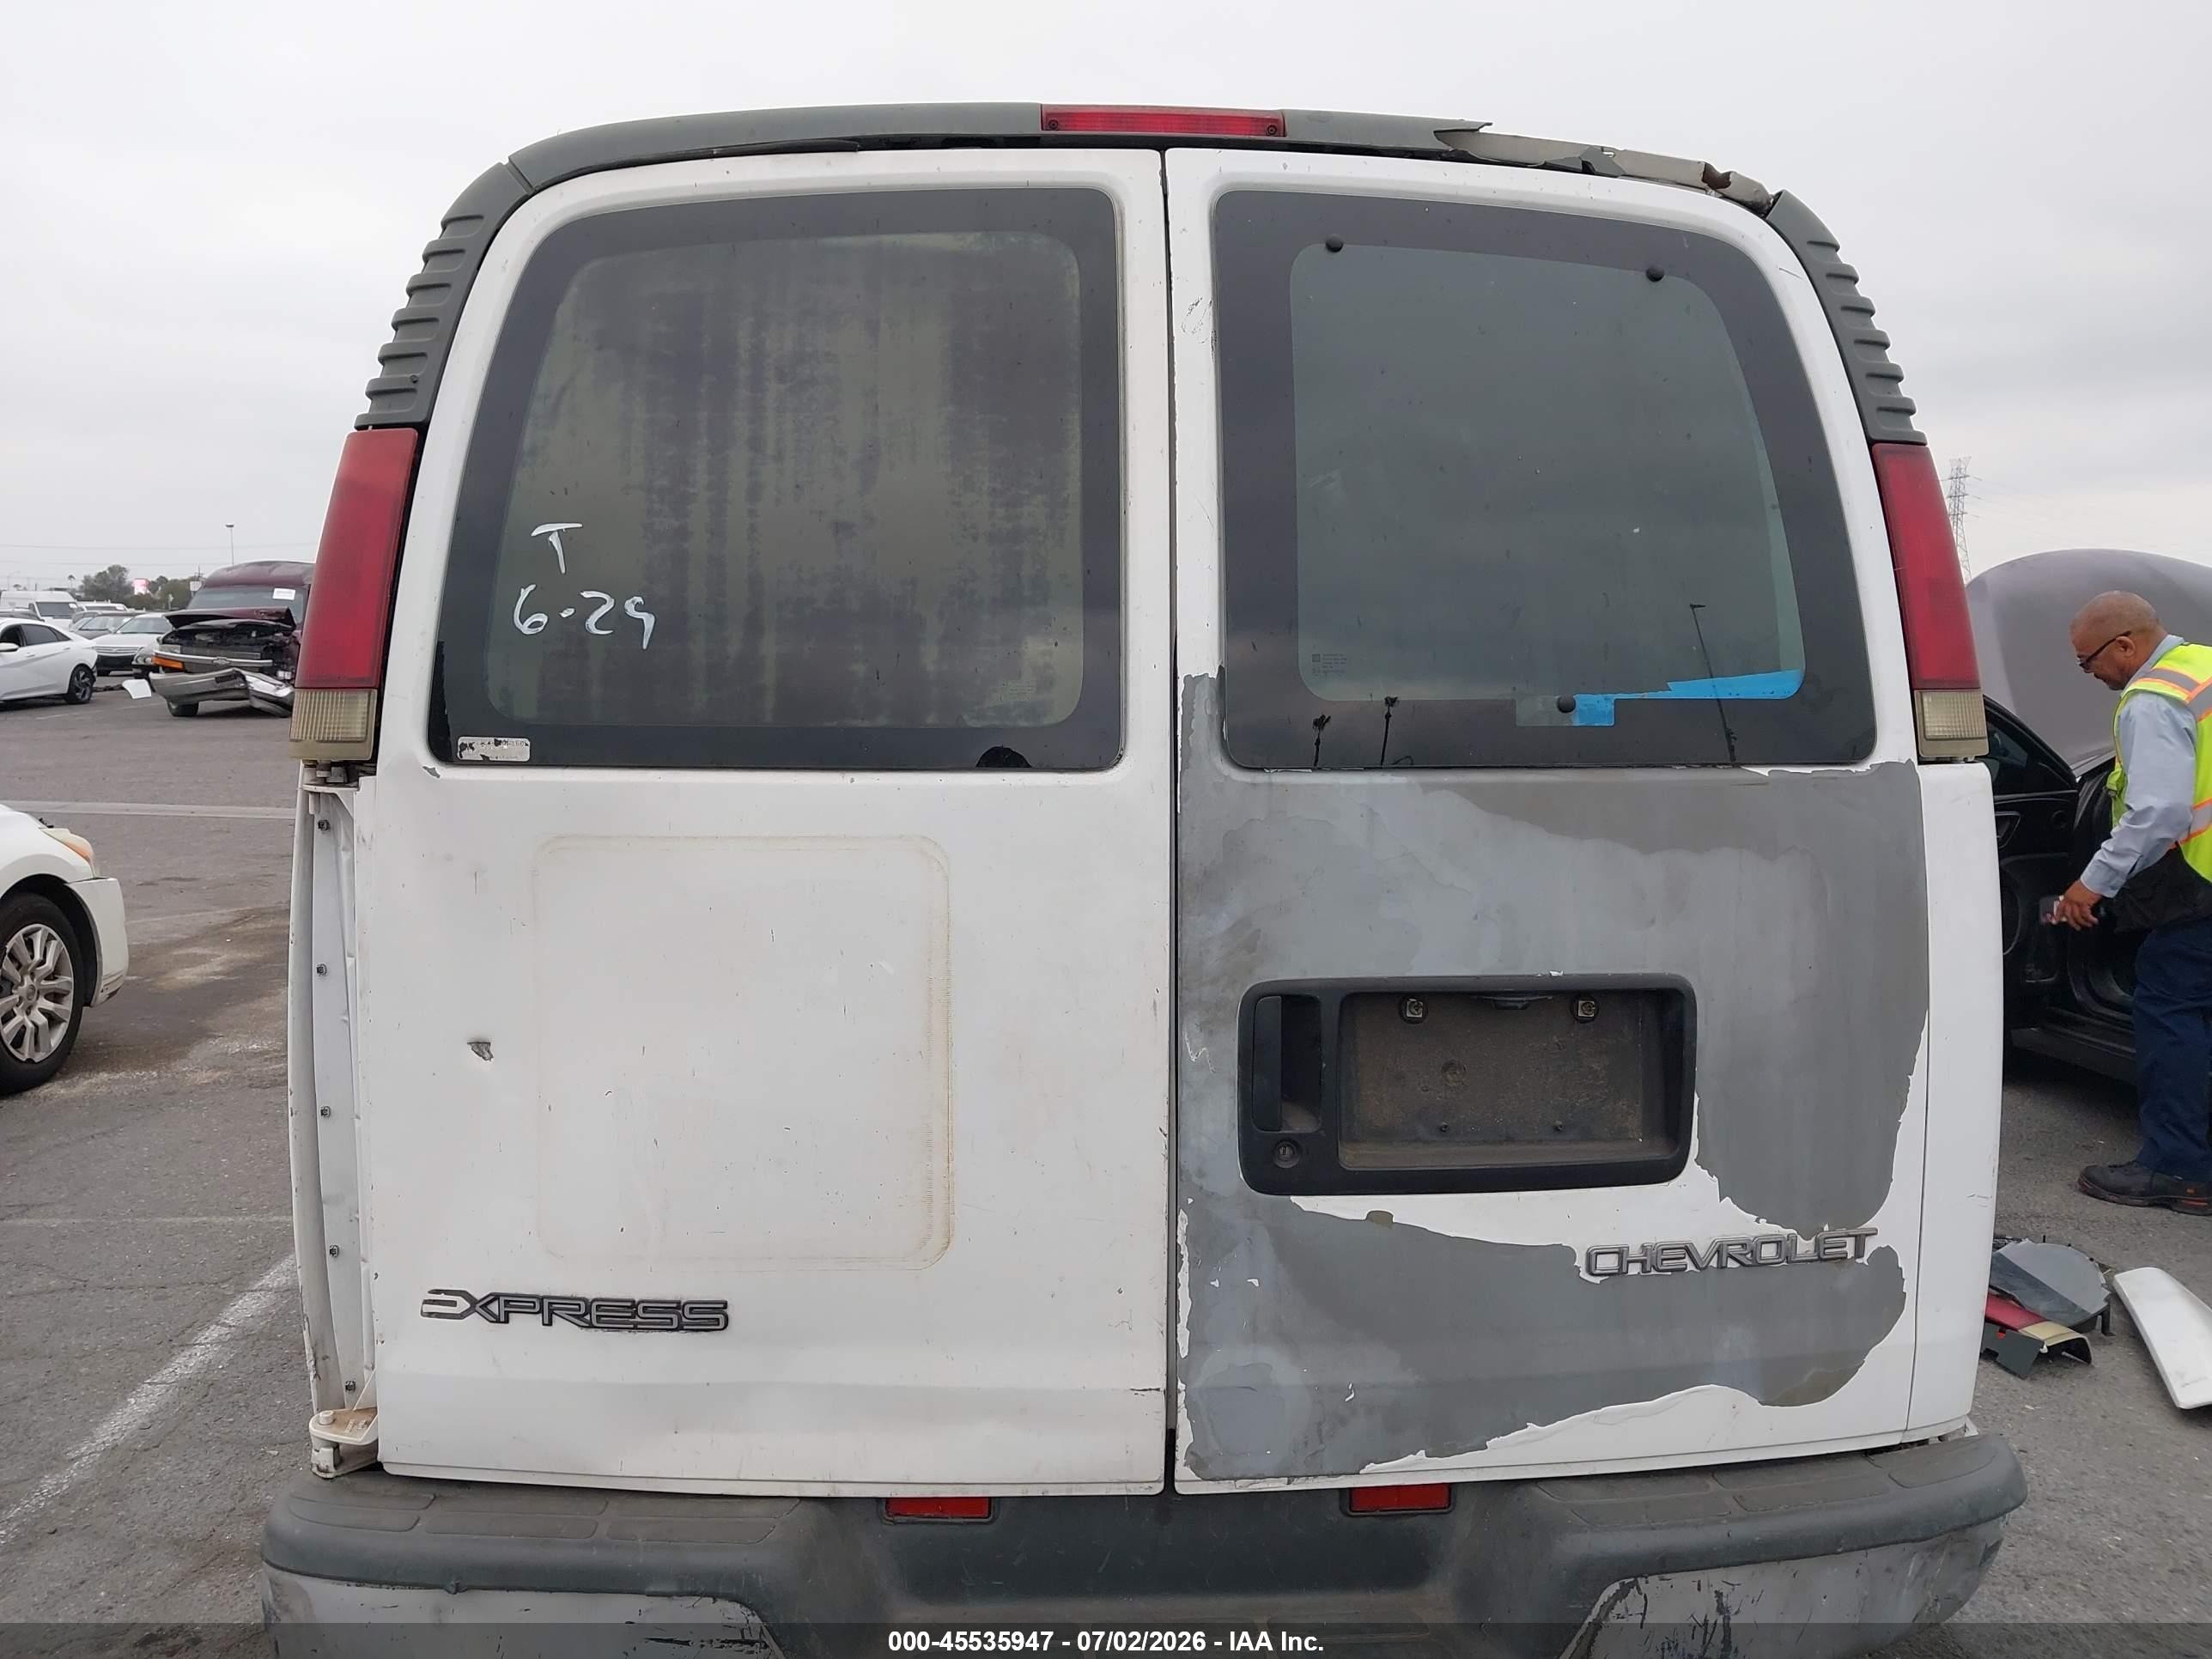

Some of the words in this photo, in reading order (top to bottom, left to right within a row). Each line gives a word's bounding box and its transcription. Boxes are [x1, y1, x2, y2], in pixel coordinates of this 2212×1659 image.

[530, 521, 583, 574] T
[513, 582, 656, 651] 6-29
[1585, 1226, 1879, 1276] CHEVROLET
[420, 1288, 729, 1332] EXPRESS
